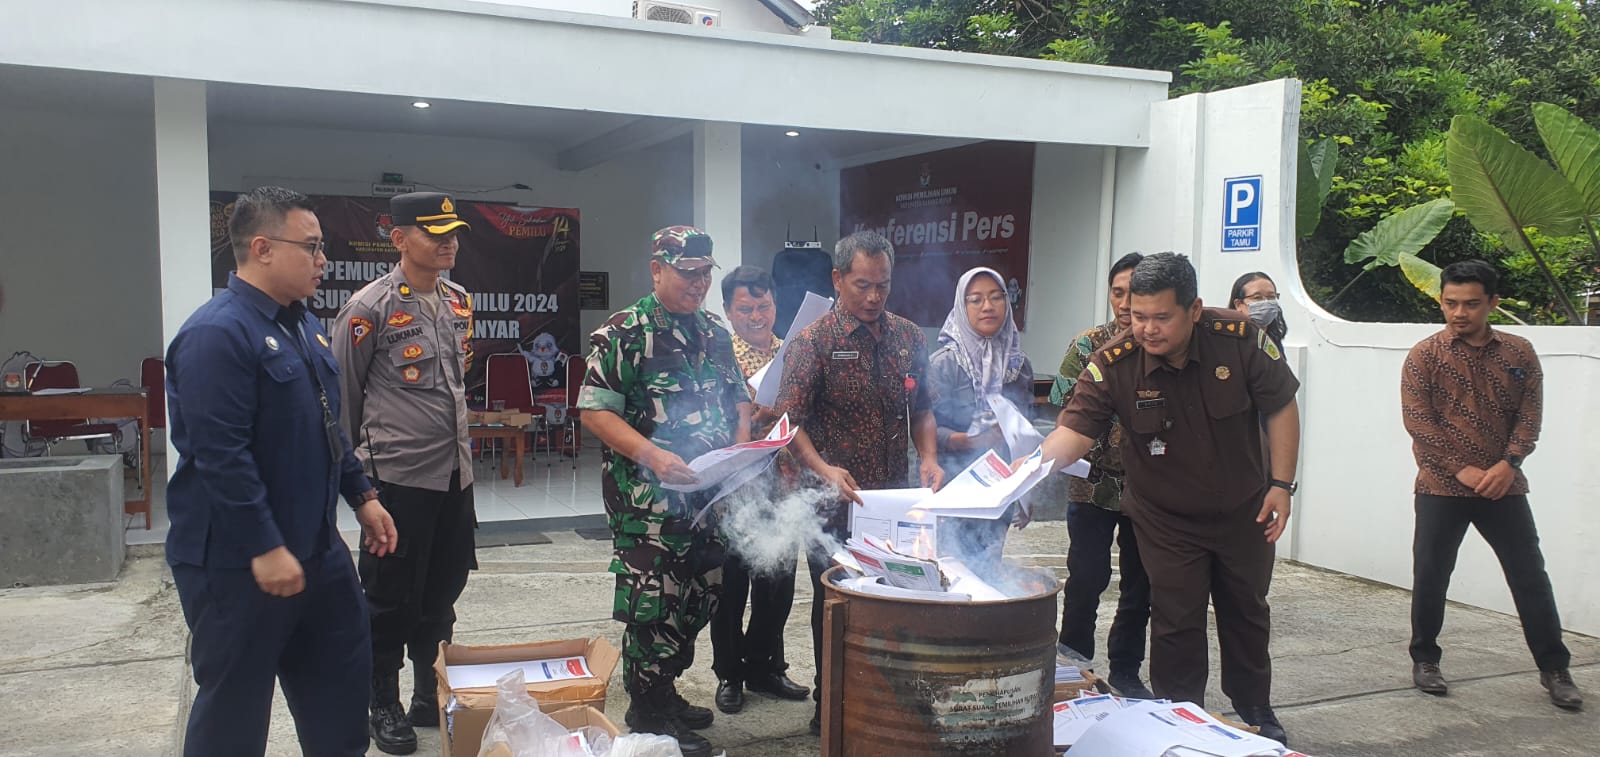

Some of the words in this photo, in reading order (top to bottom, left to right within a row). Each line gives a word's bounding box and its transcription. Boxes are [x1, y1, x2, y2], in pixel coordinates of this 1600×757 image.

[1231, 183, 1254, 223] P
[509, 226, 546, 237] PEMILU
[963, 211, 1015, 241] Pers
[1228, 229, 1254, 238] PARKIR
[1231, 239, 1251, 247] TAMU
[513, 293, 559, 313] 2024
[386, 326, 424, 344] LUKMAN
